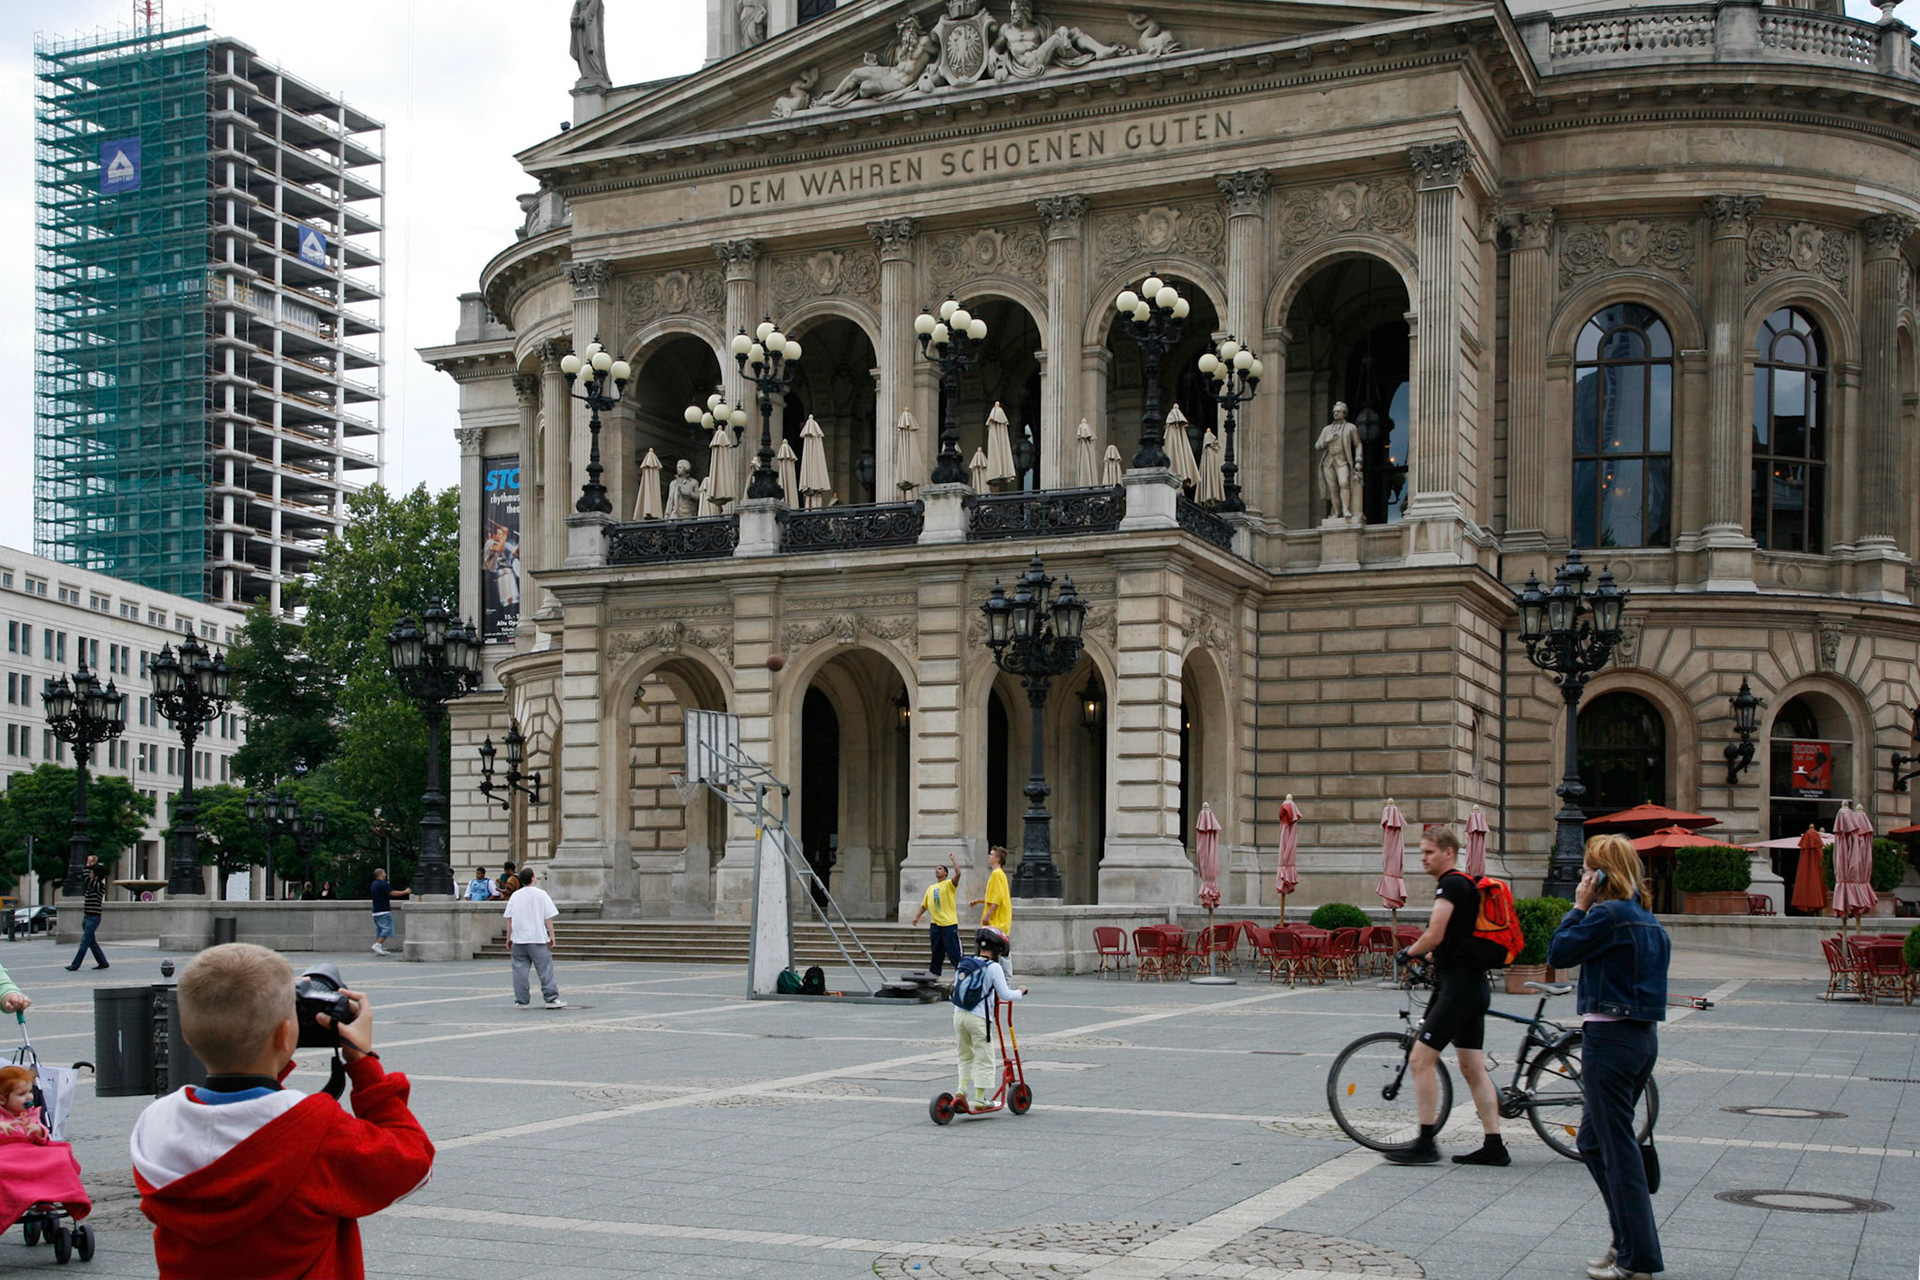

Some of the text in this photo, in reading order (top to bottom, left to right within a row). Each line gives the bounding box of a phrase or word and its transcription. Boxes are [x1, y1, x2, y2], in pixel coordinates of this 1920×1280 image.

[729, 110, 1244, 208] DEM WAHREN SCHOENEN GUTEN.
